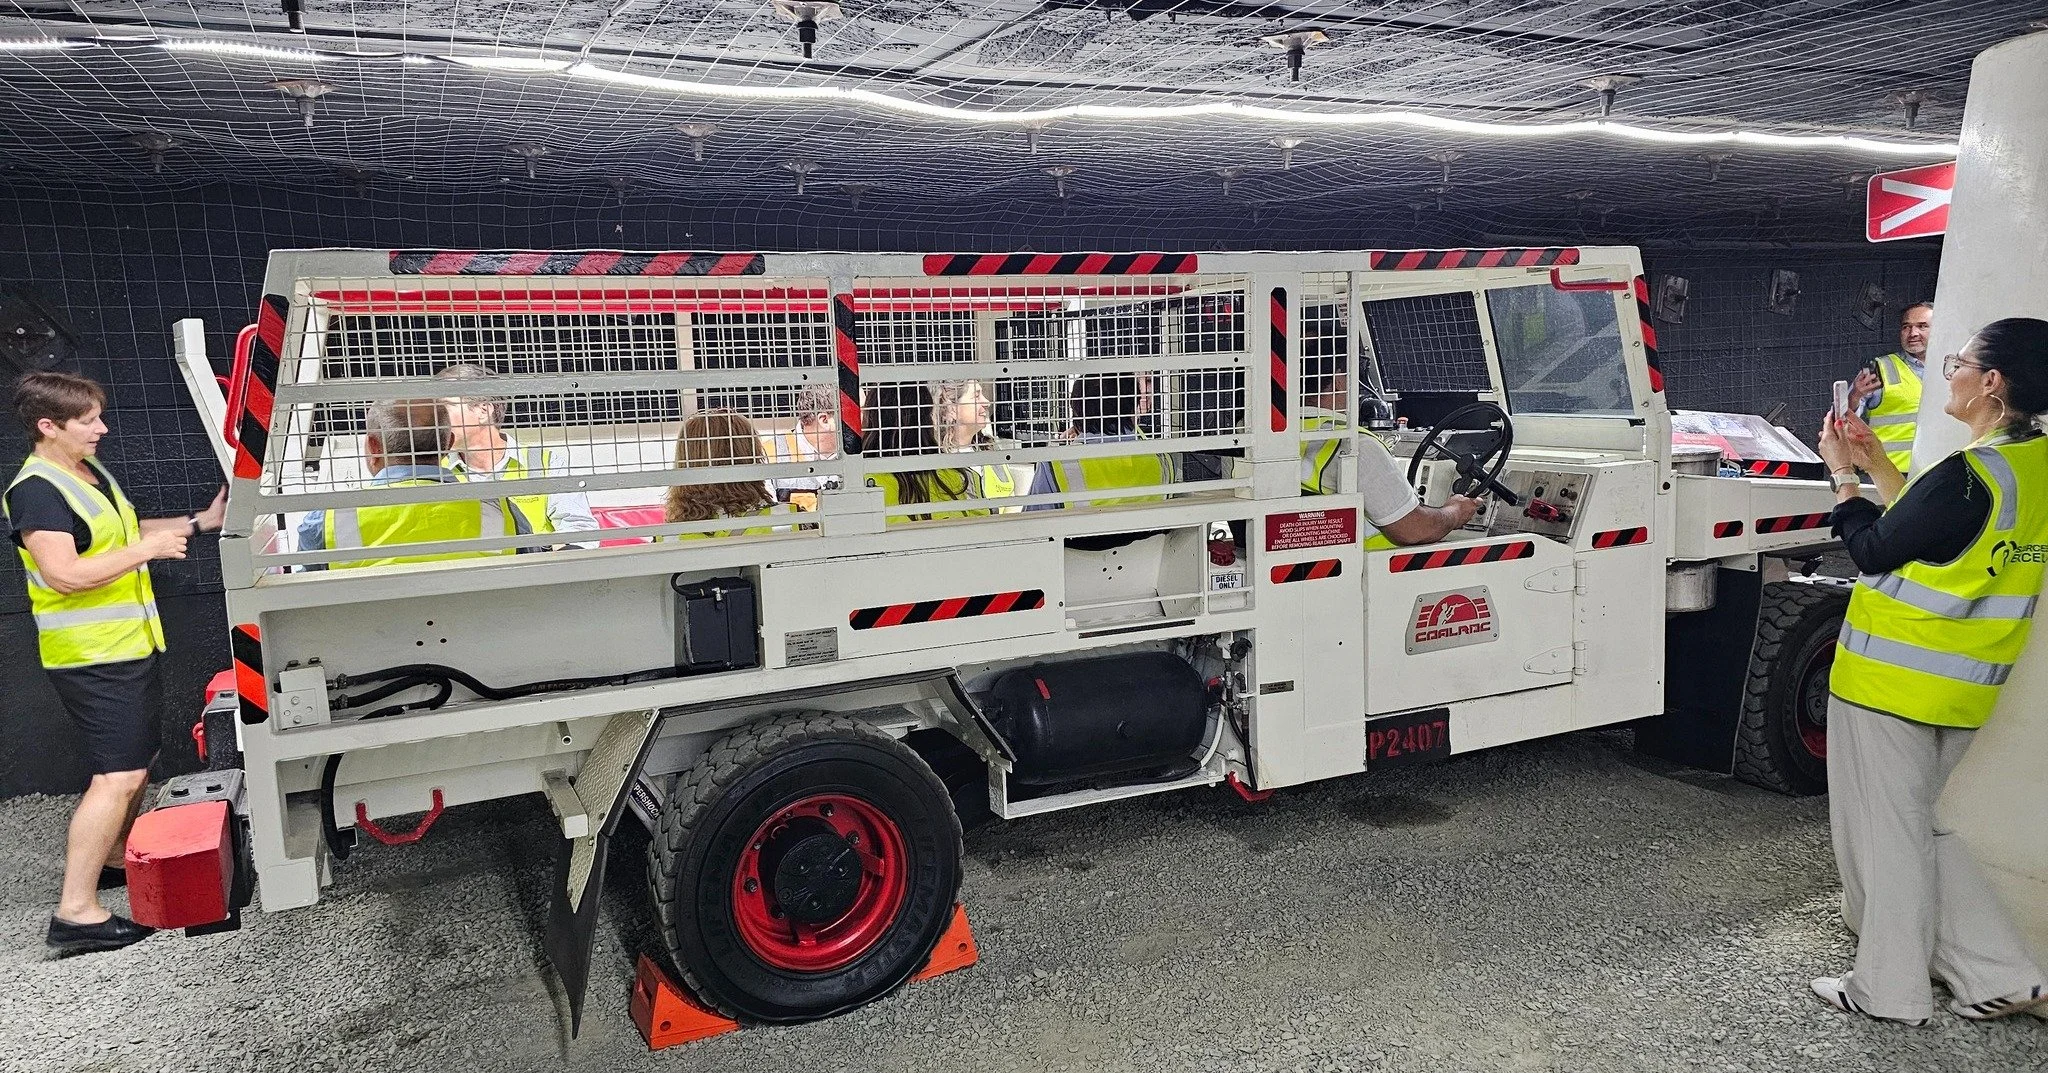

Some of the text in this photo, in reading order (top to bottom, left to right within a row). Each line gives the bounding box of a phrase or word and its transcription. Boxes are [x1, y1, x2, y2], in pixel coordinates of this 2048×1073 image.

[1320, 523, 1344, 531] MOUNTING
[1290, 530, 1320, 538] DISMOUNTING
[1289, 541, 1312, 549] REMOVING
[1415, 621, 1491, 643] COALROC
[1369, 720, 1447, 760] P2407
